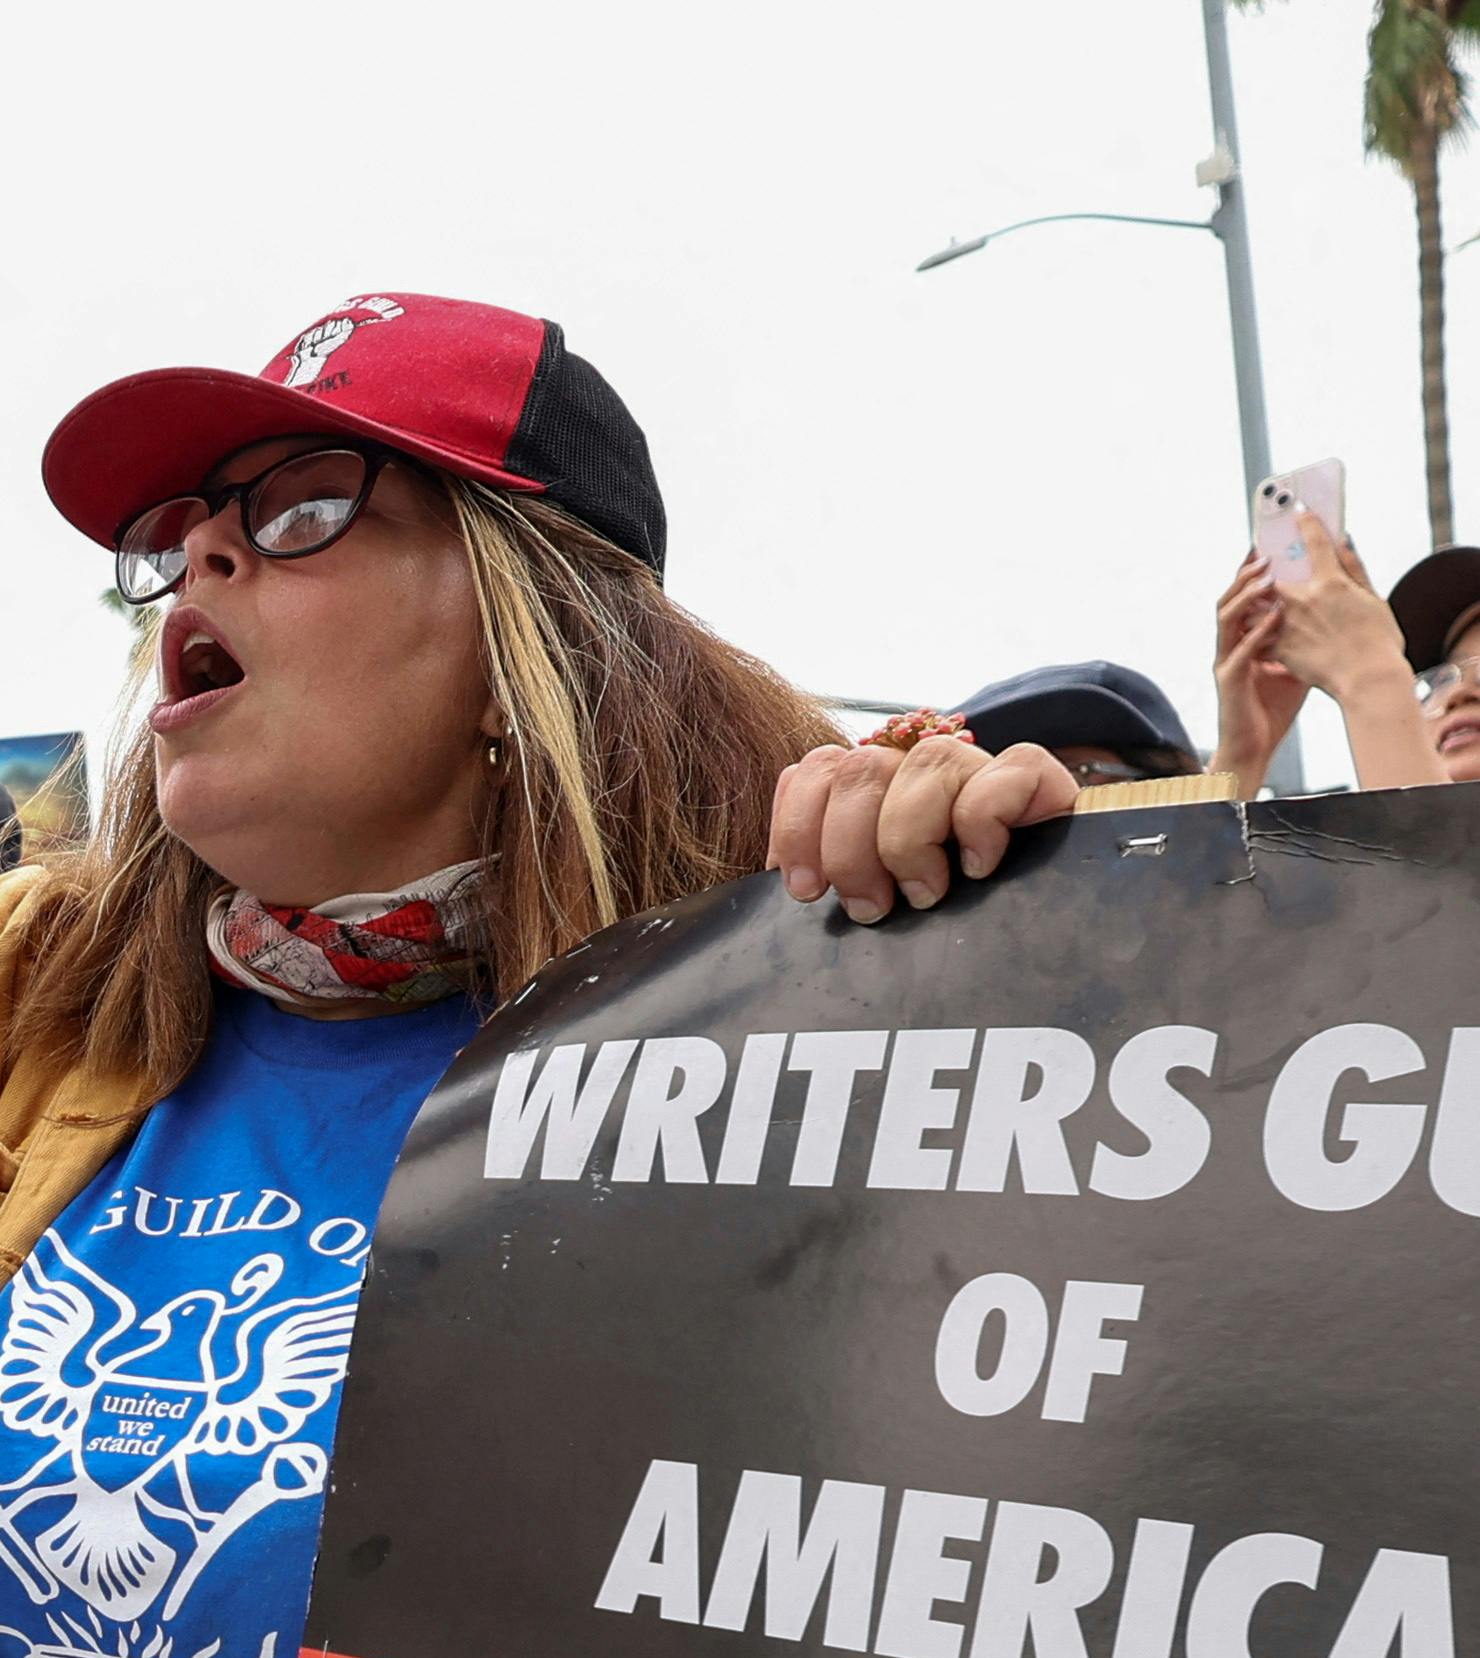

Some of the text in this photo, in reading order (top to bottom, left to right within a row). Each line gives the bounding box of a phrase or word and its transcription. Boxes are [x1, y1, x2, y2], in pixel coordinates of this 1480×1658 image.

[481, 1023, 1219, 1202] WRITERS
[934, 1270, 1146, 1423] OF
[102, 1391, 193, 1421] united
[118, 1417, 155, 1440] we
[86, 1432, 167, 1457] stand
